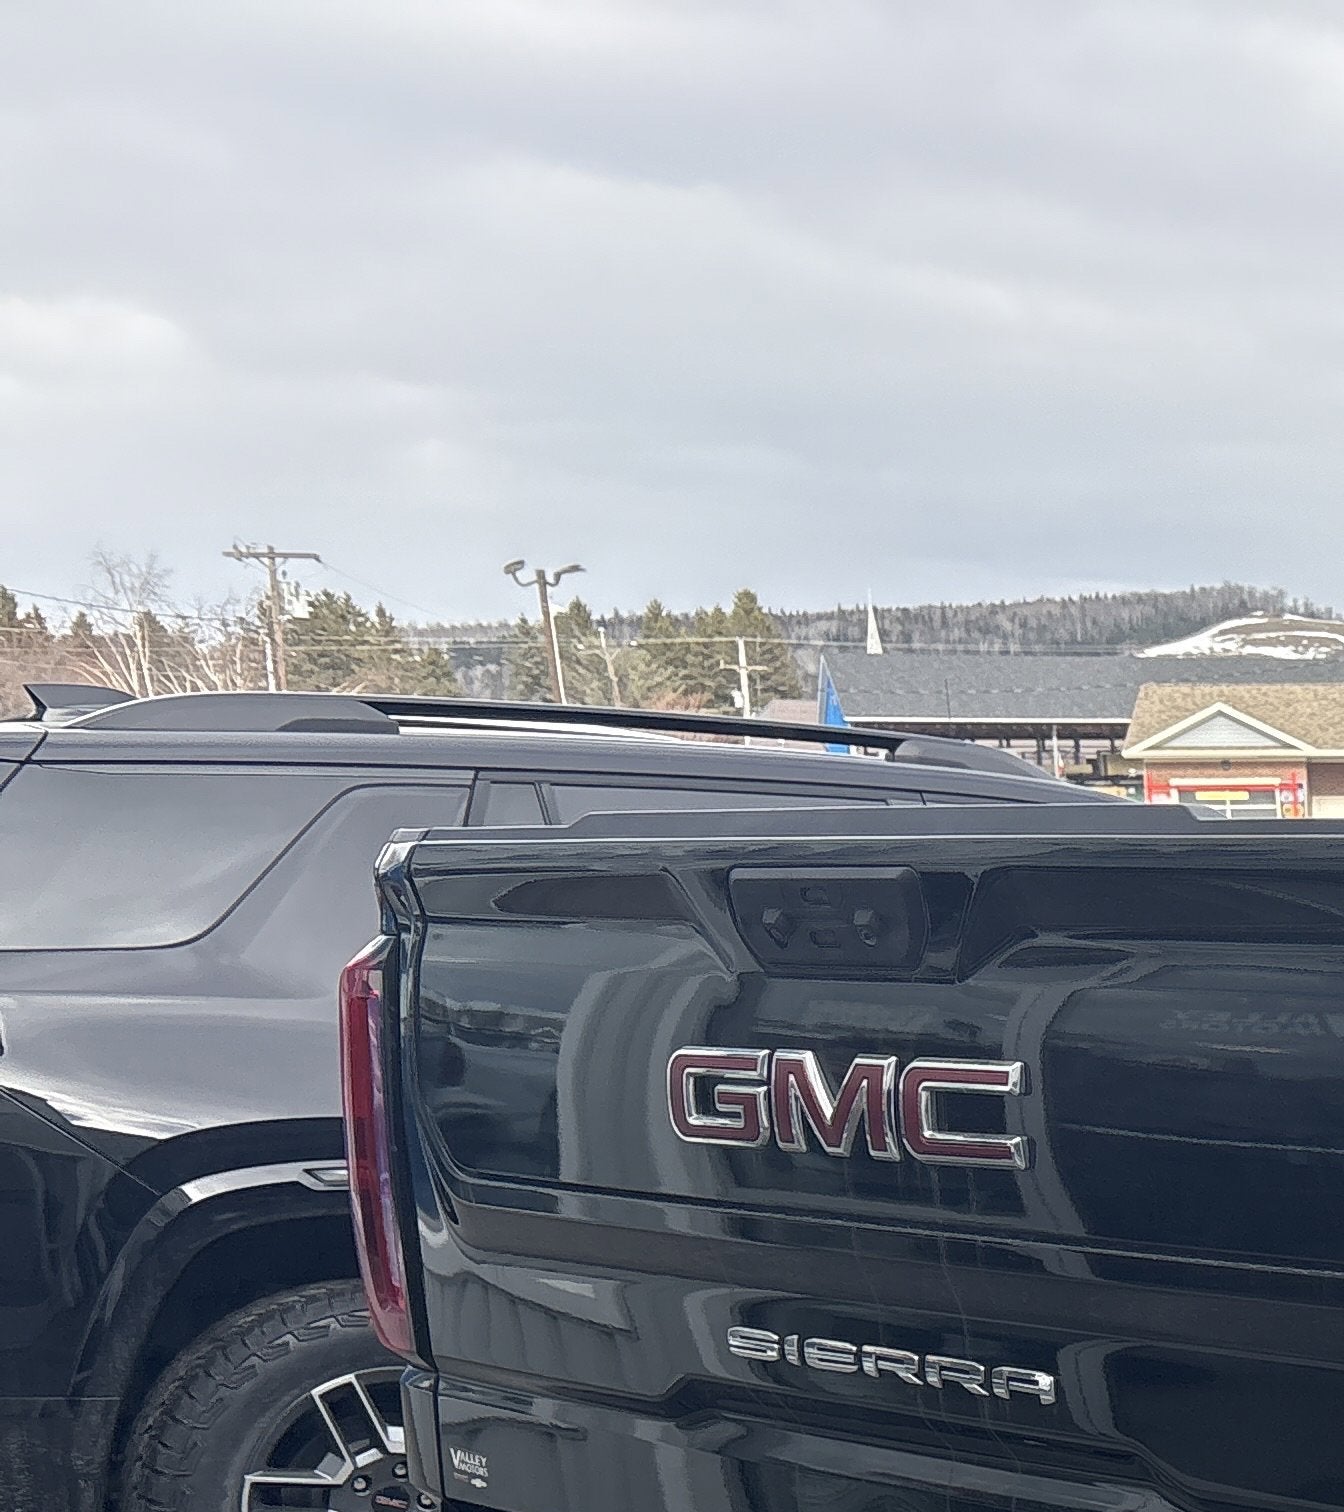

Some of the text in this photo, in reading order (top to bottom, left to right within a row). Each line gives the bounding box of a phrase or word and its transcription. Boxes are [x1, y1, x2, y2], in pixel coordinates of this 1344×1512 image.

[666, 1044, 1032, 1171] GMC
[727, 1325, 1056, 1405] SIERRA
[449, 1447, 487, 1469] VALLEY
